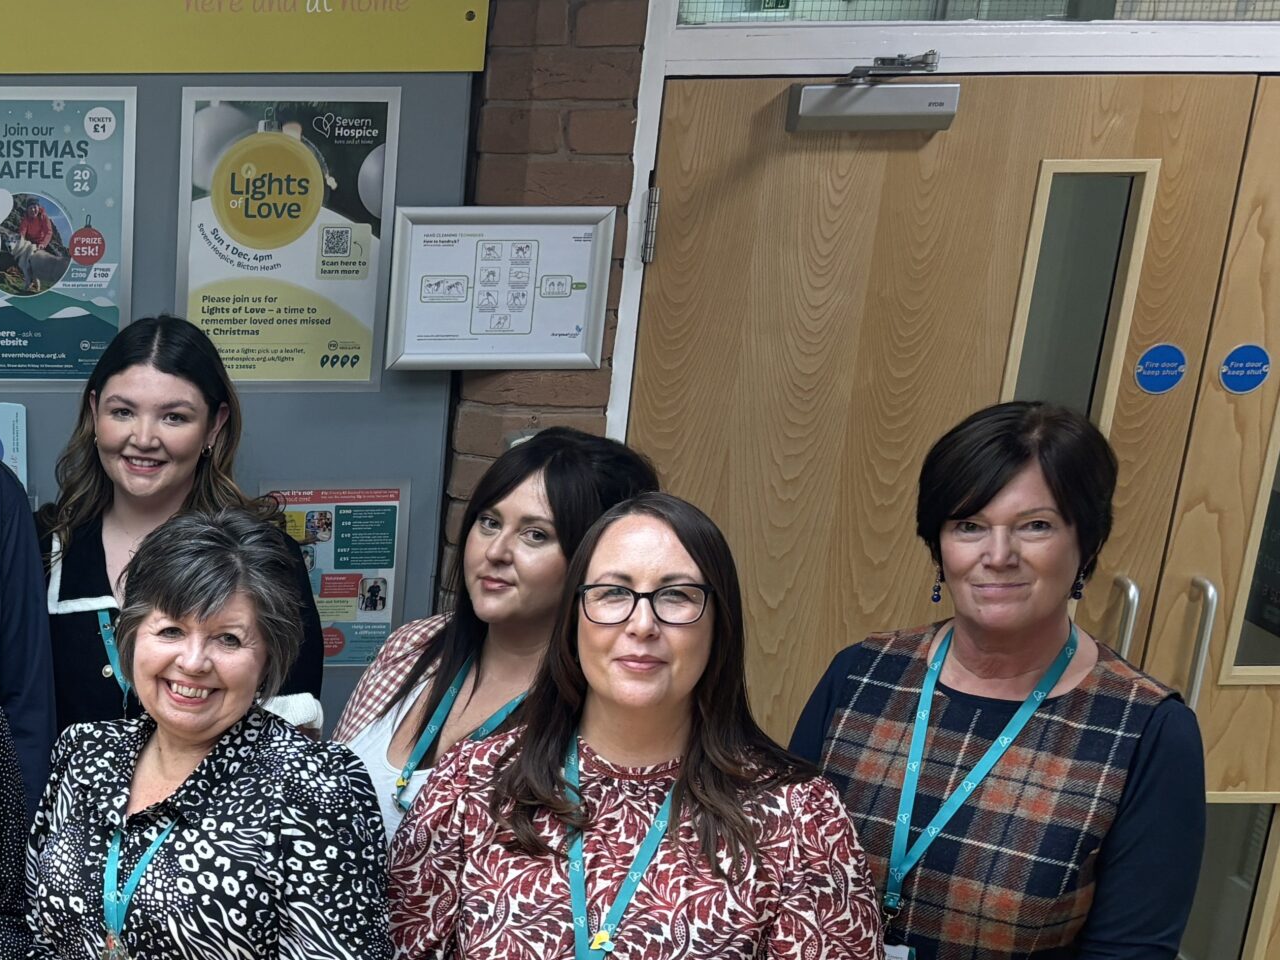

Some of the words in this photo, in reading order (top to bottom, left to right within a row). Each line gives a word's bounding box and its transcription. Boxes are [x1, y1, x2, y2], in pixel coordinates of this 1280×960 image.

[336, 116, 372, 127] Severn
[3, 123, 28, 138] Join
[31, 124, 54, 136] our
[92, 124, 106, 133] £1
[334, 127, 378, 138] Hospice
[73, 170, 90, 180] 20
[73, 182, 90, 192] 24
[230, 172, 310, 201] Lights
[230, 197, 244, 209] of
[244, 198, 302, 219] Love
[198, 223, 212, 248] Severn
[210, 246, 235, 267] Hospice,
[236, 261, 259, 272] Bicton
[260, 262, 282, 272] Heath
[210, 228, 225, 246] Sun
[231, 246, 251, 262] Dec,
[252, 253, 273, 262] 4pm
[73, 246, 99, 256] £5k!
[202, 295, 230, 303] Please
[232, 295, 250, 304] join
[264, 295, 278, 303] for
[202, 306, 230, 315] Lights
[232, 306, 243, 314] of
[244, 306, 266, 314] Love
[284, 306, 304, 314] time
[201, 318, 248, 326] remember
[250, 317, 274, 325] loved
[300, 317, 330, 325] missed
[212, 328, 260, 336] Christmas
[1, 352, 66, 360] severnhospice.org.uk
[258, 348, 270, 356] pick
